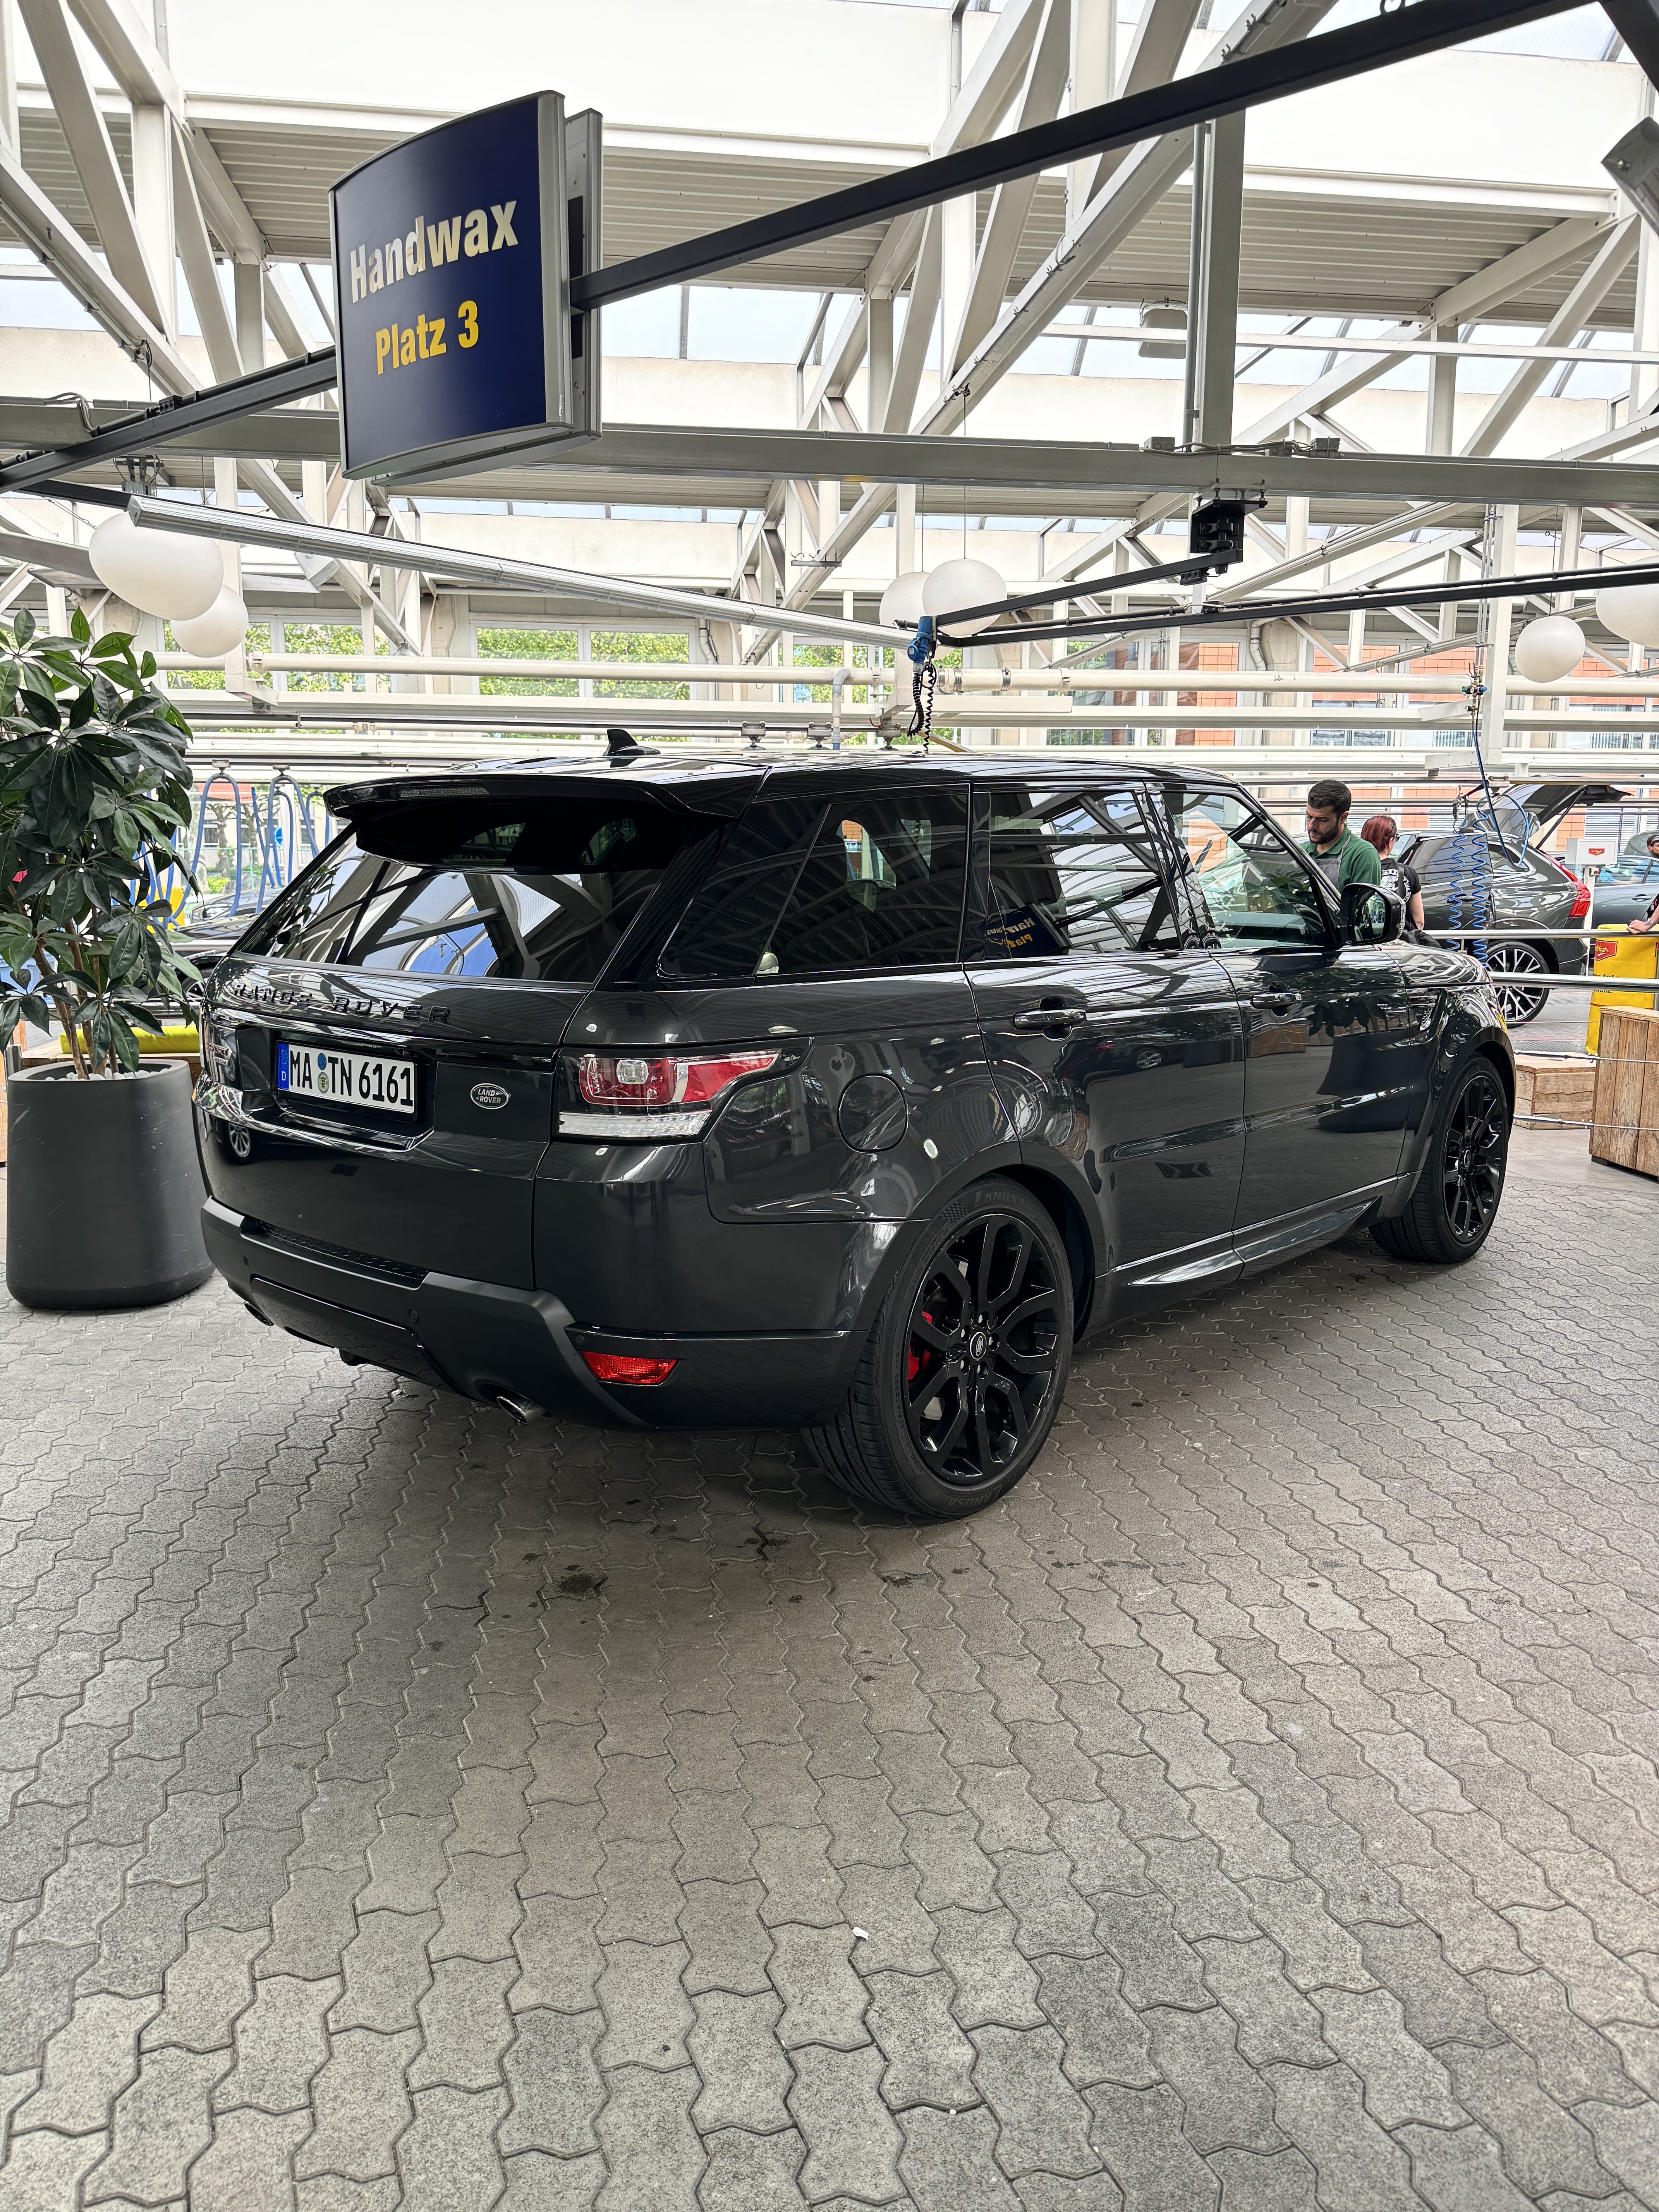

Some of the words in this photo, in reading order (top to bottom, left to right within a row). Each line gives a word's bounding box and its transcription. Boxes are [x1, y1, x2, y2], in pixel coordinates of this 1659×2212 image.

[350, 200, 519, 304] Handwax
[376, 314, 446, 375] Platz
[458, 300, 479, 349] 3
[233, 982, 313, 1007] RANGE
[331, 996, 450, 1024] ROVER
[282, 1071, 287, 1081] D
[290, 1050, 313, 1089] MA
[328, 1056, 352, 1097] TN
[359, 1061, 413, 1107] 6161
[477, 1088, 496, 1096] LAND
[479, 1096, 501, 1104] ROVER
